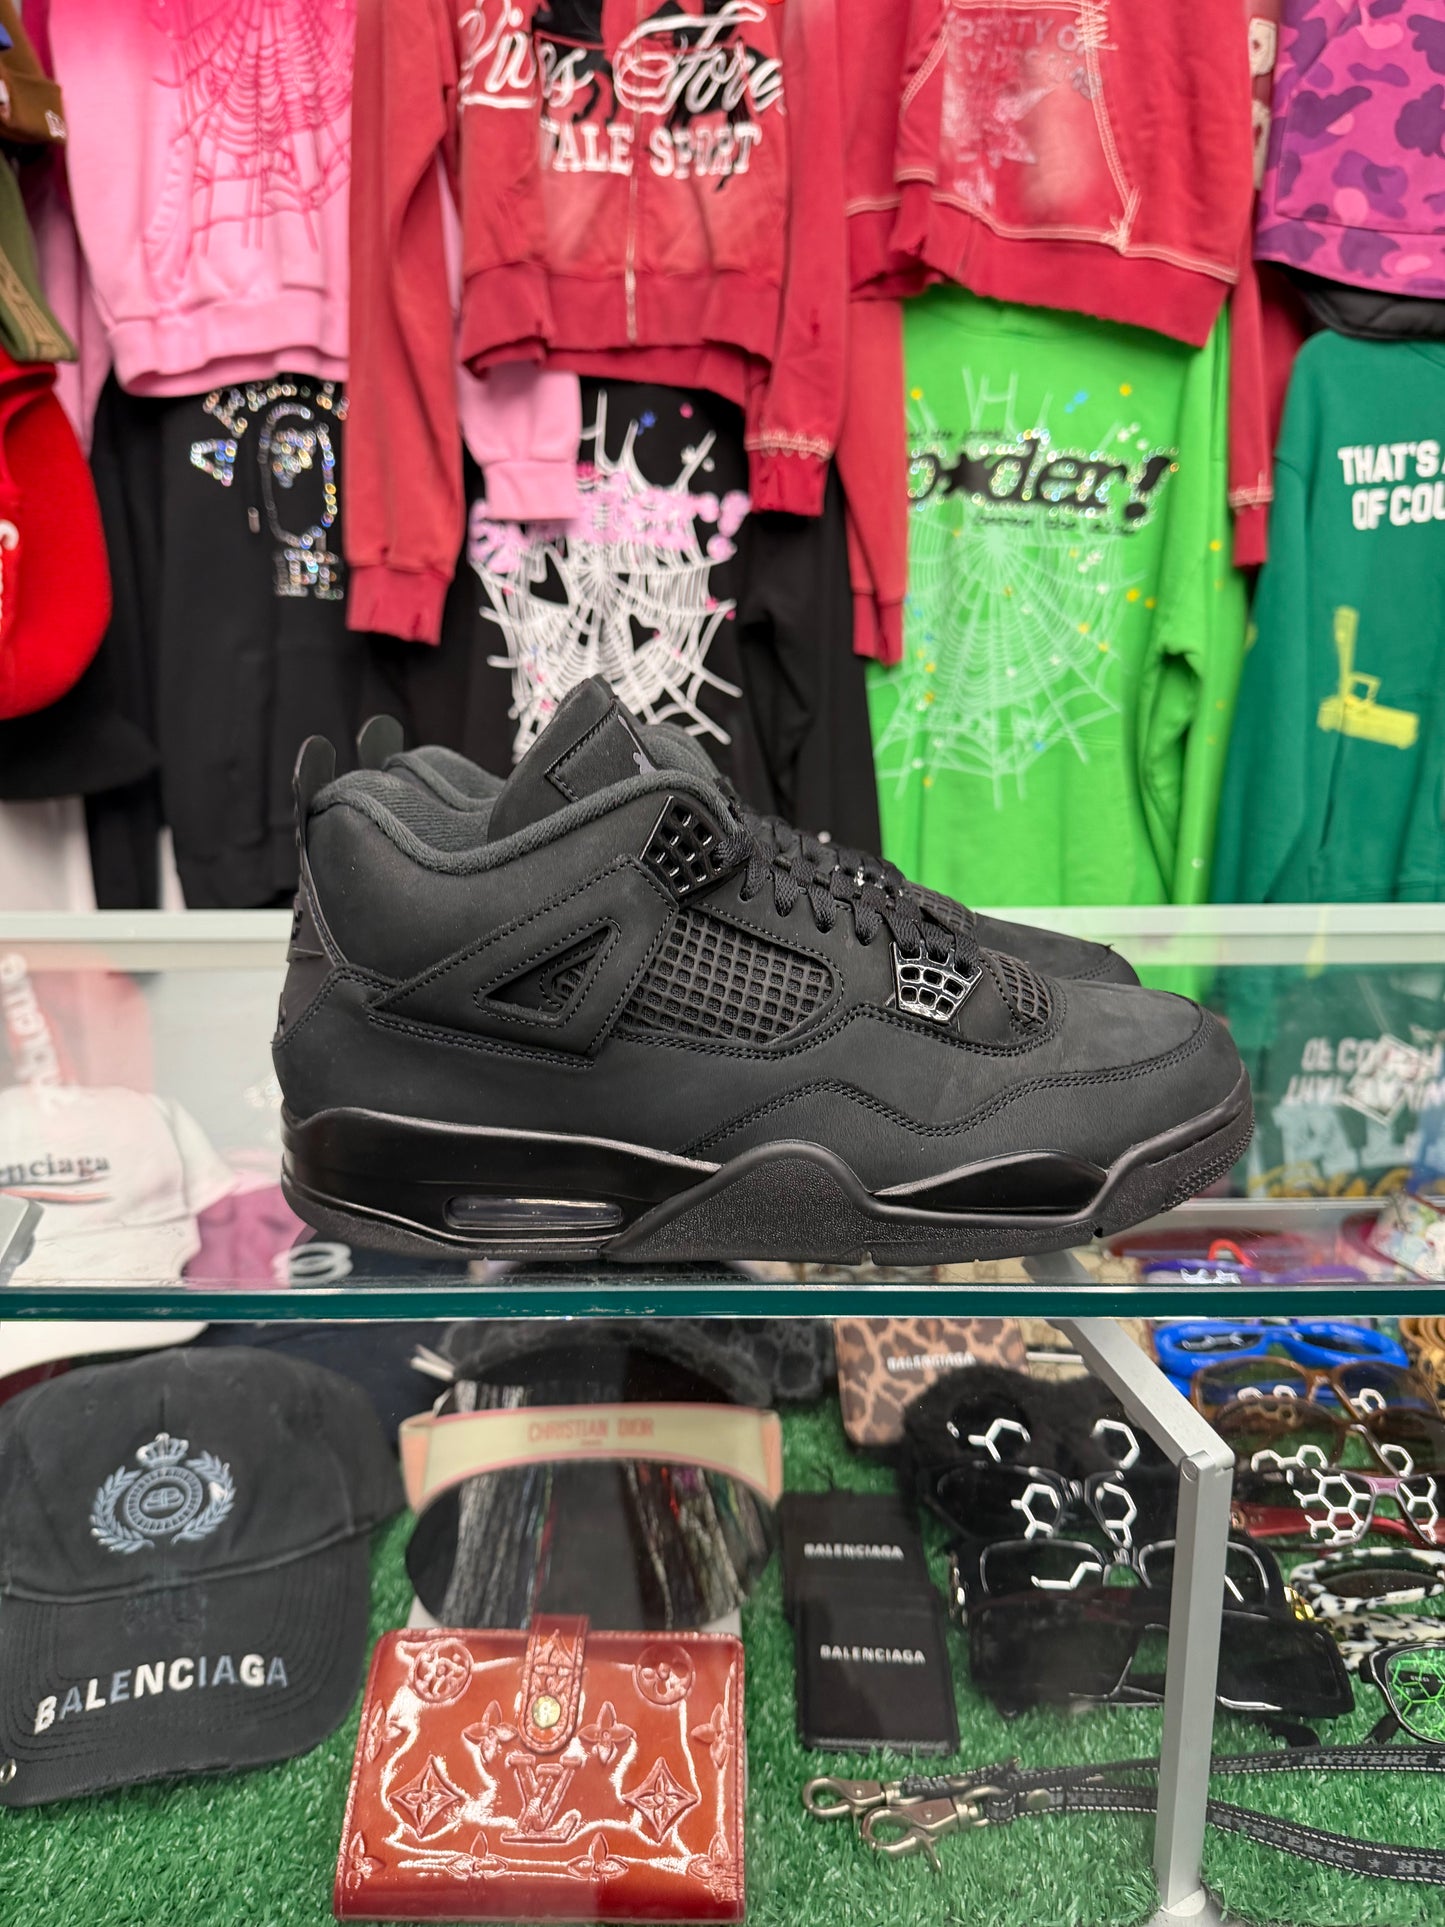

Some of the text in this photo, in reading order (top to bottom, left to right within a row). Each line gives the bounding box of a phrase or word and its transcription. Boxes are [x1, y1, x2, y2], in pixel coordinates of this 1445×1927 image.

[1337, 439, 1440, 485] THAT'S
[1352, 488, 1388, 531] OF
[0, 1153, 111, 1183] nciaga
[819, 1644, 926, 1664] BALENCIAGA
[34, 1653, 289, 1735] BALENCIAGA
[1302, 1754, 1428, 1766] HYSTERIC
